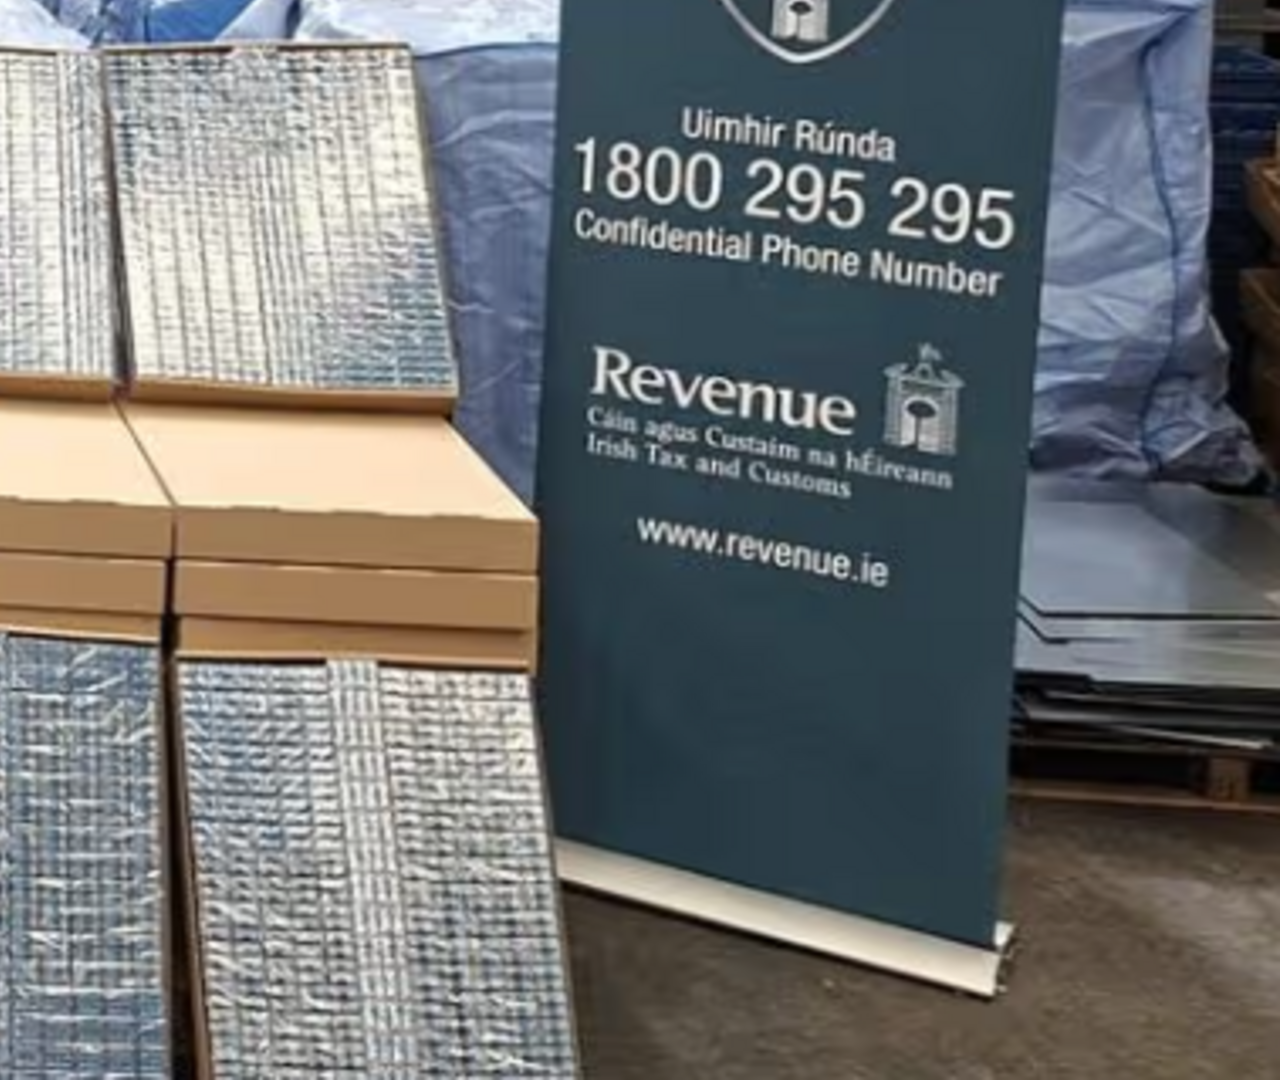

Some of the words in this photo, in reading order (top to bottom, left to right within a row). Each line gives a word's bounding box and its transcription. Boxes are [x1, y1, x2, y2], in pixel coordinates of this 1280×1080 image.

[683, 107, 786, 147] Uimhir
[795, 120, 895, 161] Rúnda
[574, 137, 723, 211] 1800
[745, 156, 868, 228] 295
[888, 178, 1013, 248] 295
[575, 208, 753, 262] Confidential
[762, 234, 860, 276] Phone
[871, 250, 1001, 295] Number
[591, 346, 856, 436] Revenue
[587, 406, 638, 433] Cáin
[645, 422, 700, 446] agus
[704, 425, 801, 462] Custaim
[807, 448, 837, 470] na
[844, 447, 954, 489] hÉireann
[587, 433, 638, 461] Irish
[645, 443, 689, 471] Tax
[696, 455, 742, 480] and
[748, 462, 853, 499] Customs
[637, 517, 889, 587] www.revenue.ie
